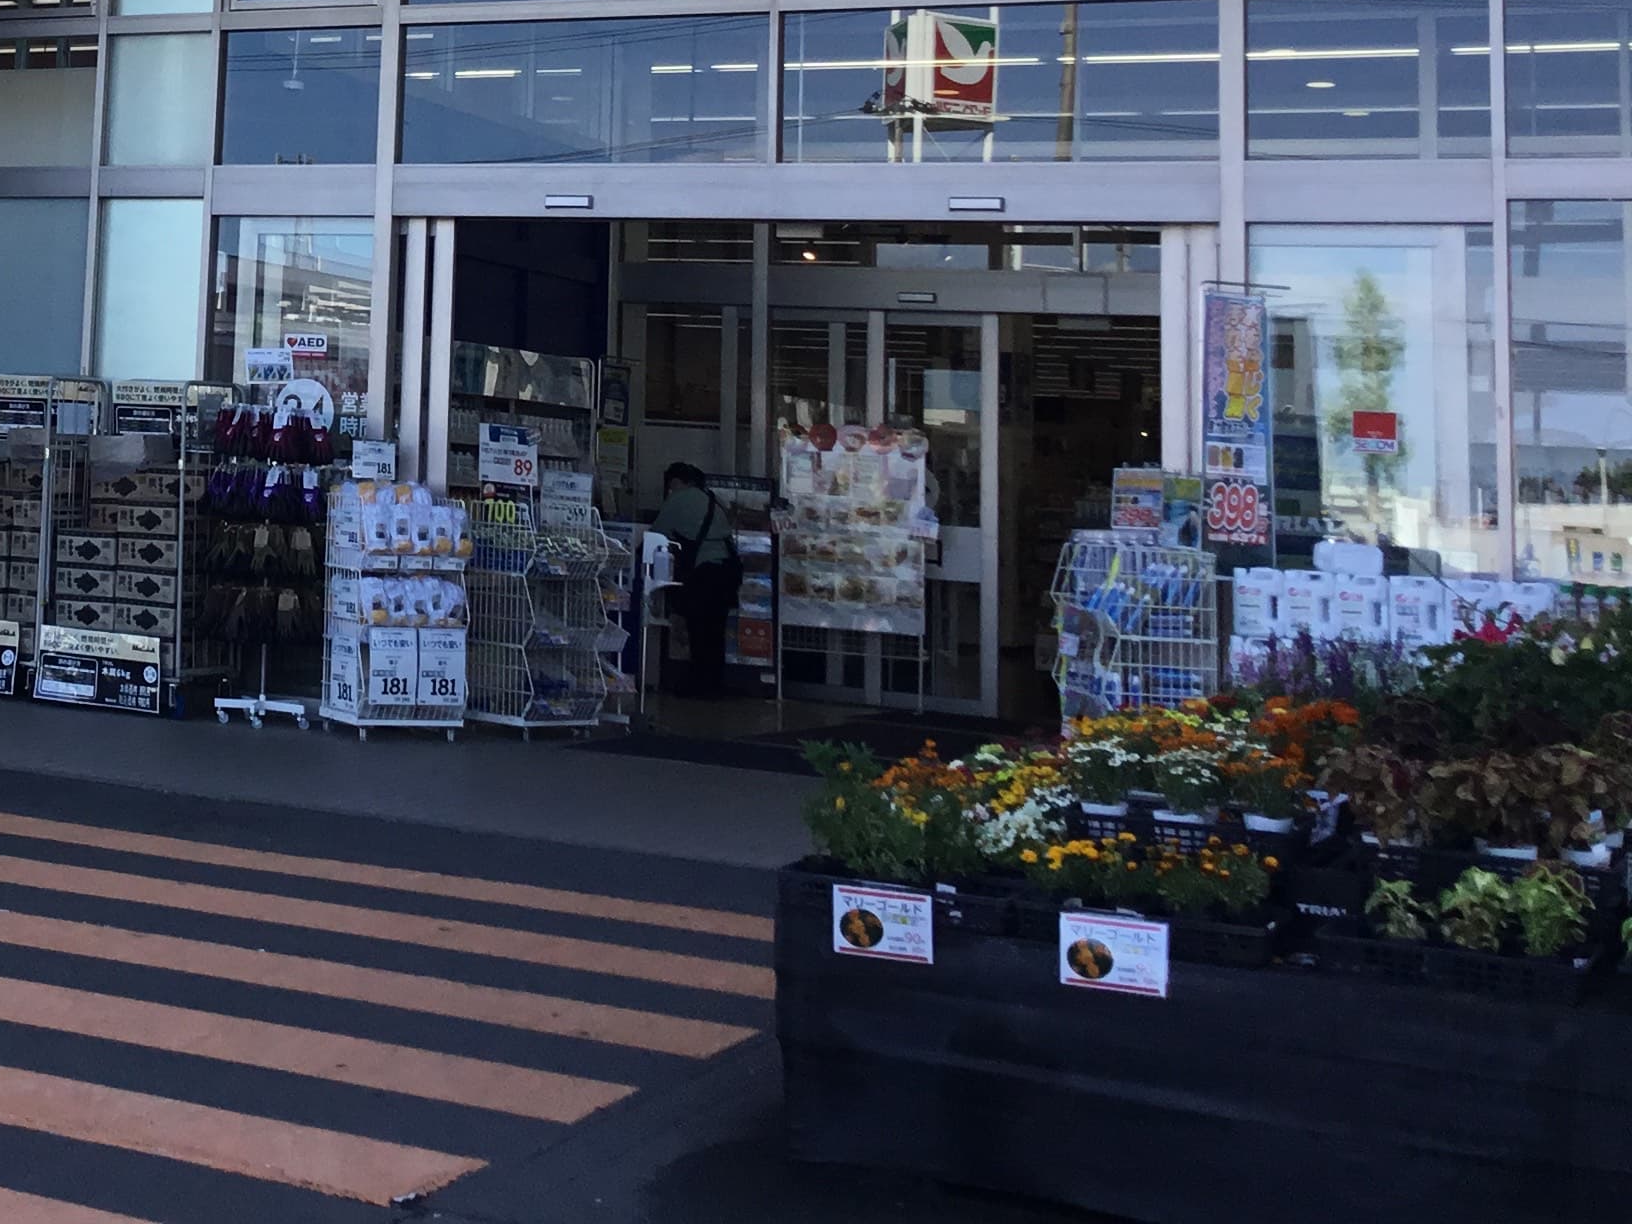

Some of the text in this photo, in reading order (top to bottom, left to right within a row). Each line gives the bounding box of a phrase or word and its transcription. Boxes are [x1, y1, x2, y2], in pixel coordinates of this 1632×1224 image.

[298, 337, 325, 348] AED
[377, 462, 392, 474] 181
[513, 458, 533, 476] 89
[1206, 482, 1258, 532] 398
[337, 682, 353, 702] 181
[381, 677, 409, 695] 181
[430, 678, 457, 696] 181
[841, 895, 923, 915] マリーゴールド
